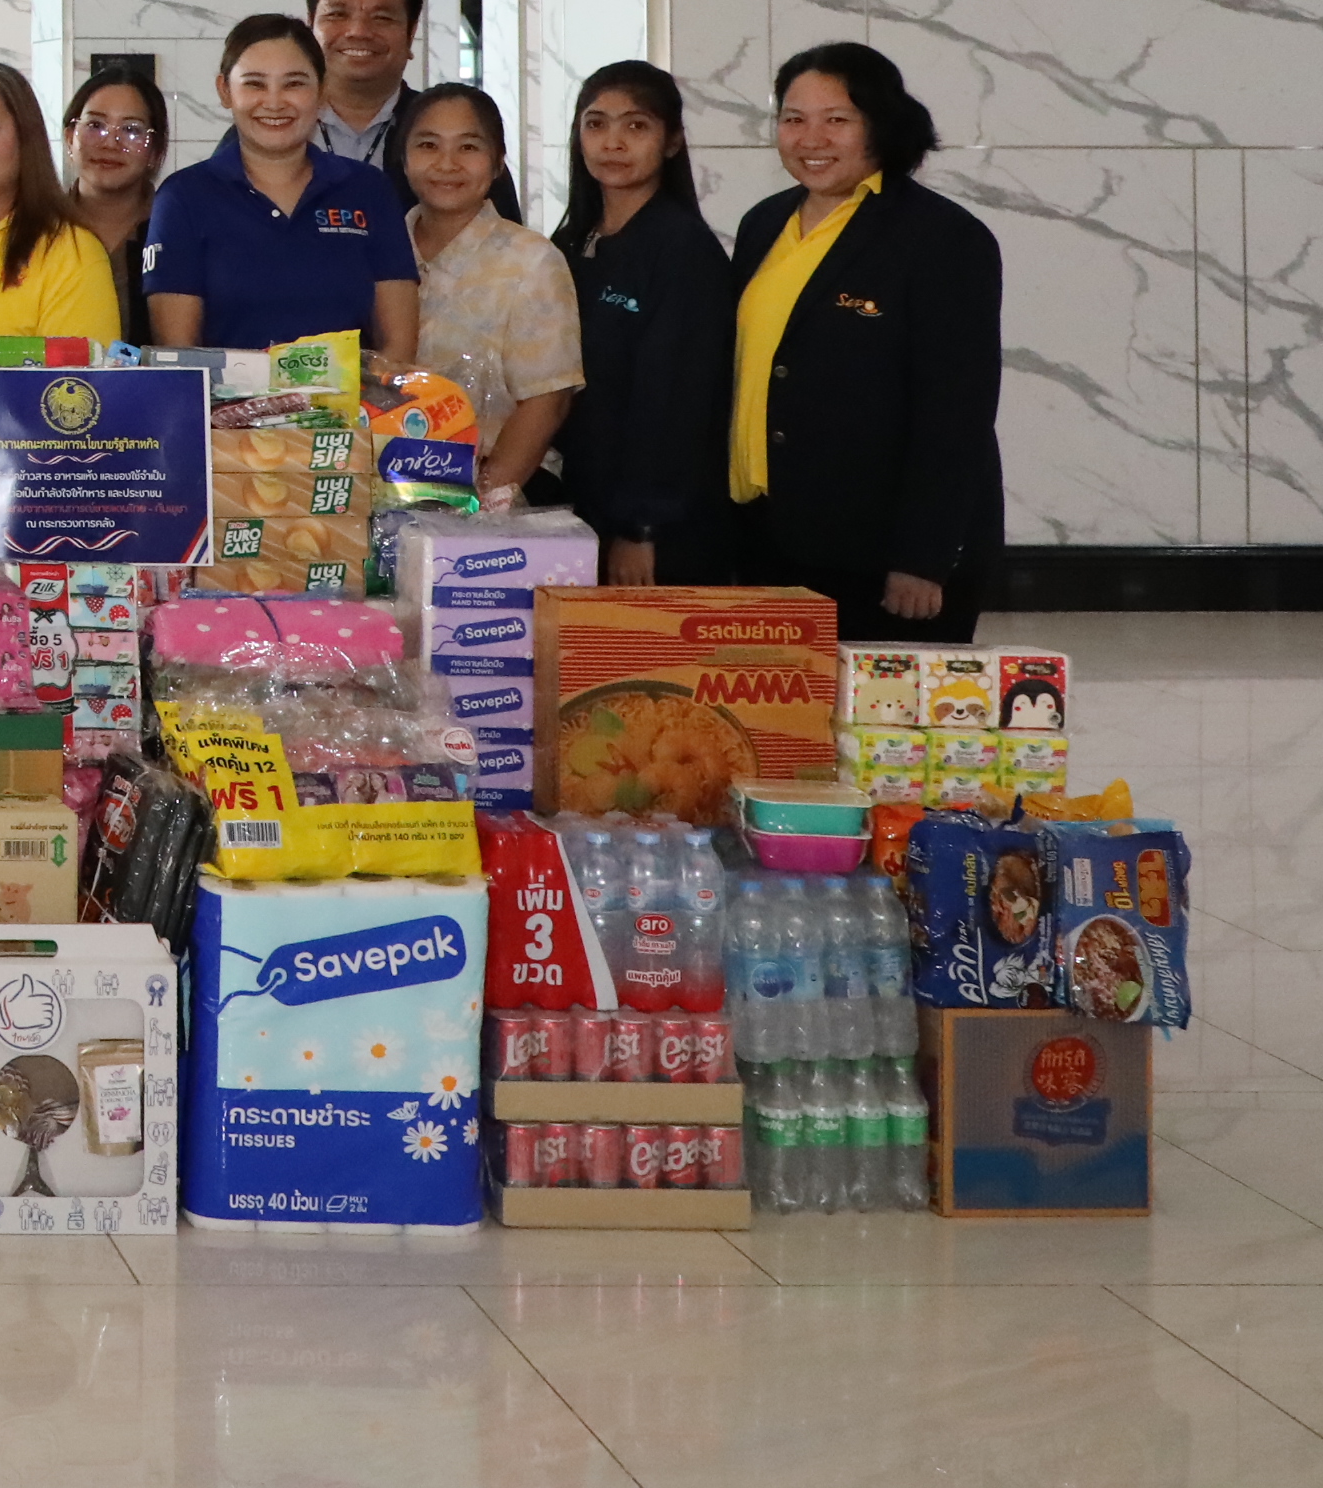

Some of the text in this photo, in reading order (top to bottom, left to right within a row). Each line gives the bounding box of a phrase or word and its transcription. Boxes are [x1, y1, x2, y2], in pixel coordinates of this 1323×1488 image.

[315, 209, 367, 228] SEPO
[387, 444, 452, 472] เขาช่อง
[54, 471, 166, 482] อาหารแห้ง และของใช้จำเป็น
[108, 489, 162, 499] และประชาชน
[39, 516, 115, 529] กระทรวงการคลัง
[225, 527, 261, 542] EURO
[223, 541, 259, 555] CAKE
[466, 551, 524, 571] Savepak
[53, 633, 62, 646] 5
[465, 621, 524, 640] Savepak
[696, 623, 803, 645] รสต้มยำกุ้ง
[58, 652, 69, 670] 1
[694, 672, 811, 705] MAMA
[461, 691, 520, 711] Savepak
[254, 760, 277, 774] 12
[211, 781, 284, 811] ฟรี 1
[517, 874, 564, 912] เพิ่ม
[640, 917, 669, 932] aro
[525, 913, 553, 961] 3
[293, 926, 458, 983] Savepak
[512, 963, 563, 986] ขวด
[229, 1103, 371, 1126] กระดาษชำระ
[229, 1134, 295, 1148] TISSUES
[229, 1190, 319, 1215] บรรจุ 40 ม้วน
